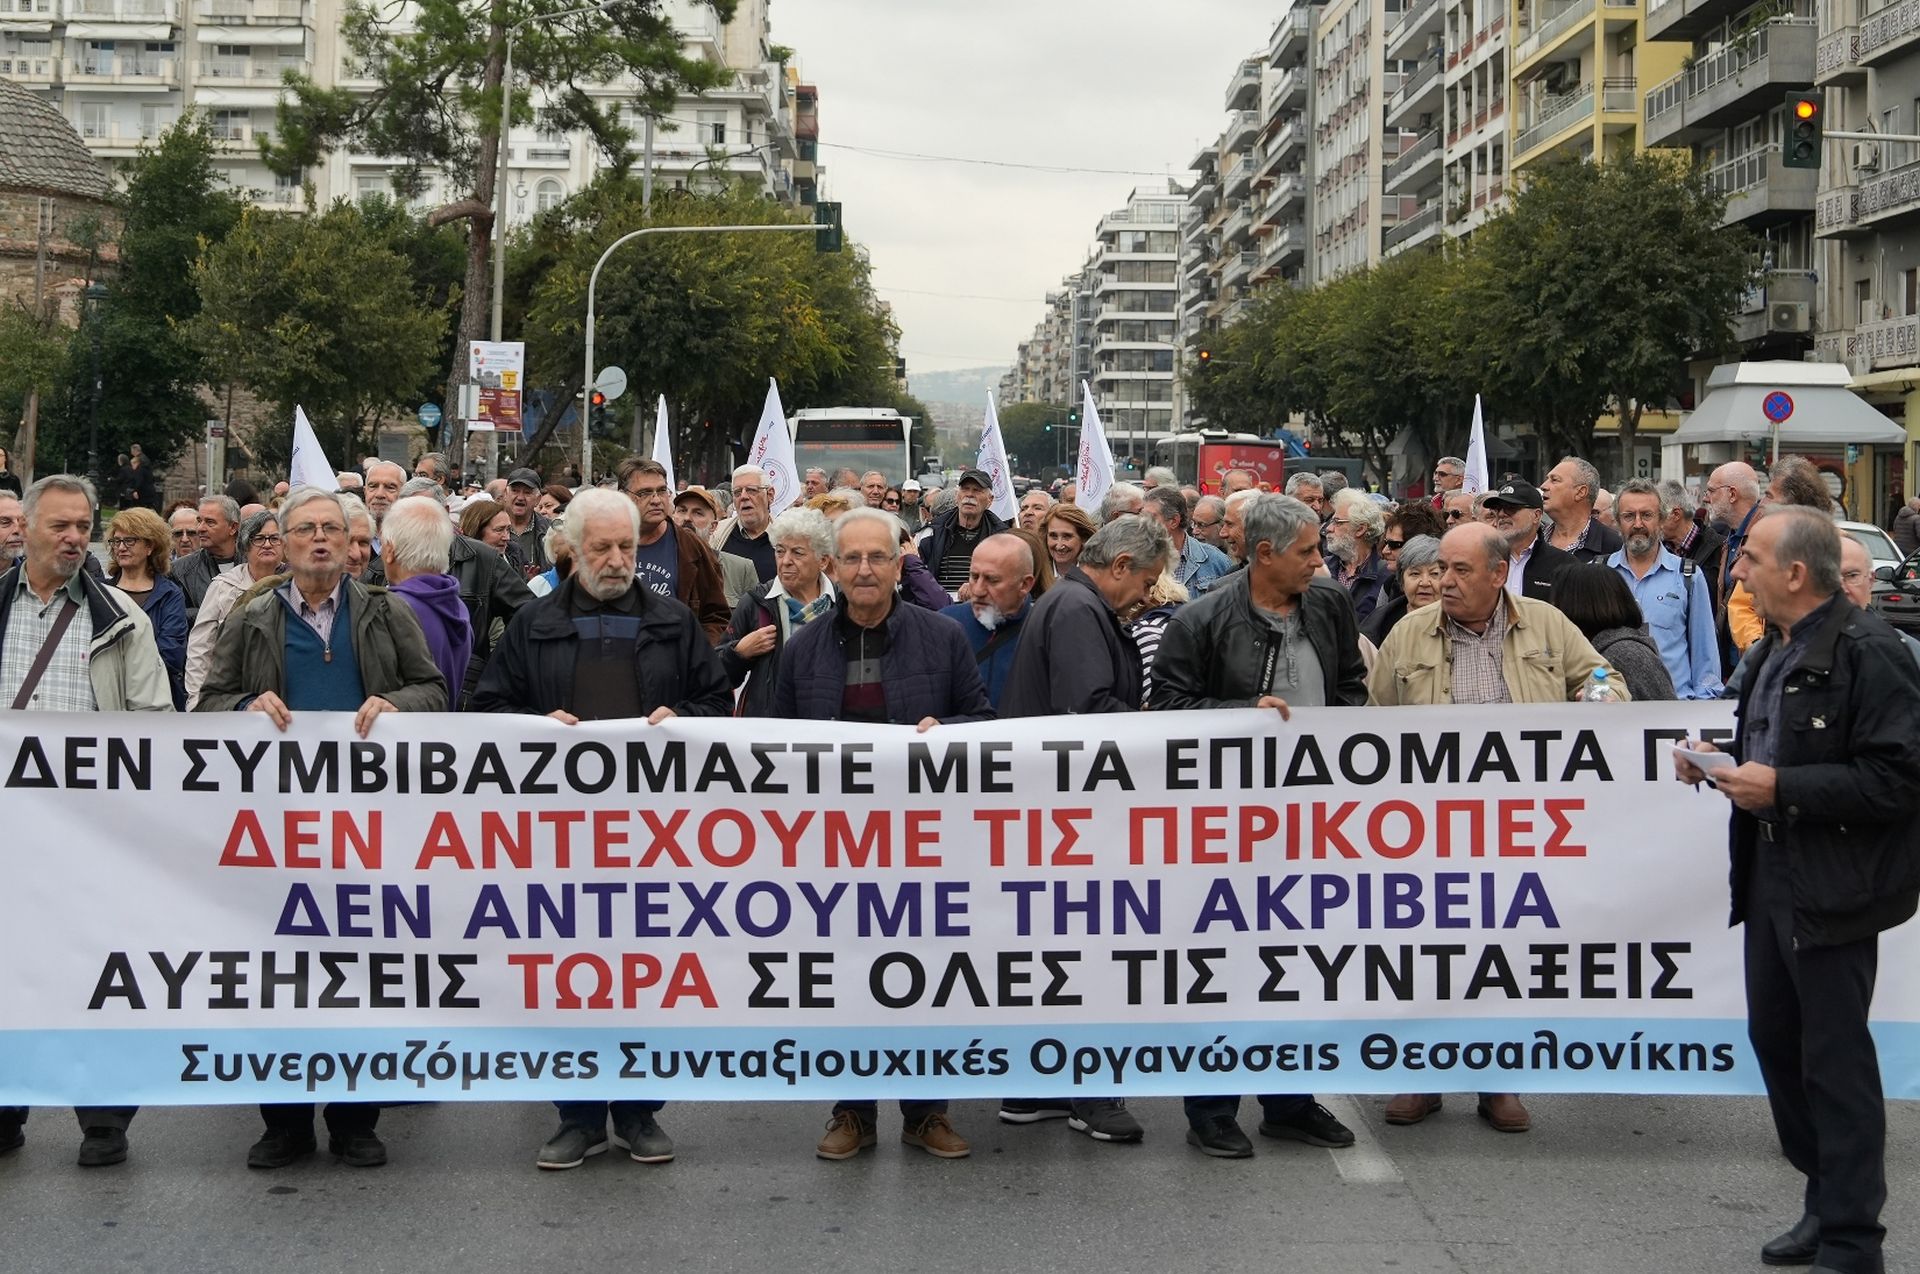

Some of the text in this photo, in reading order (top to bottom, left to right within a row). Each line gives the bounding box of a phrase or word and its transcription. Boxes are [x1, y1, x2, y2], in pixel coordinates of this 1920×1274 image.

[645, 562, 671, 579] BRAND
[5, 736, 152, 791] ΔΕΝ
[183, 739, 873, 794] ΣΥΜΒΙΒΑΖΟΜΑΣΤΕ
[908, 741, 1015, 793] ΜΕ
[1042, 740, 1136, 791] ΤΑ
[1166, 730, 1613, 789] ΕΠΙΔΟΜΑΤΑ
[219, 799, 1586, 869] ΔΕΝ ΑΝΤΕΧΟΥΜΕ ΤΙΣ ΠΕΡΙΚΟΠΕΣ
[275, 873, 1560, 939] ΔΕΝ ΑΝΤΕΧΟΥΜΕ ΤΗΝ ΑΚΡΙΒΕΙΑ
[88, 942, 1692, 1009] ΑΥΞΗΣΕΙΣ ΤΩΡΑ ΣΕ ΟΛΕΣ ΤΙΣ ΣΥΝΤΑΞΕΙΣ
